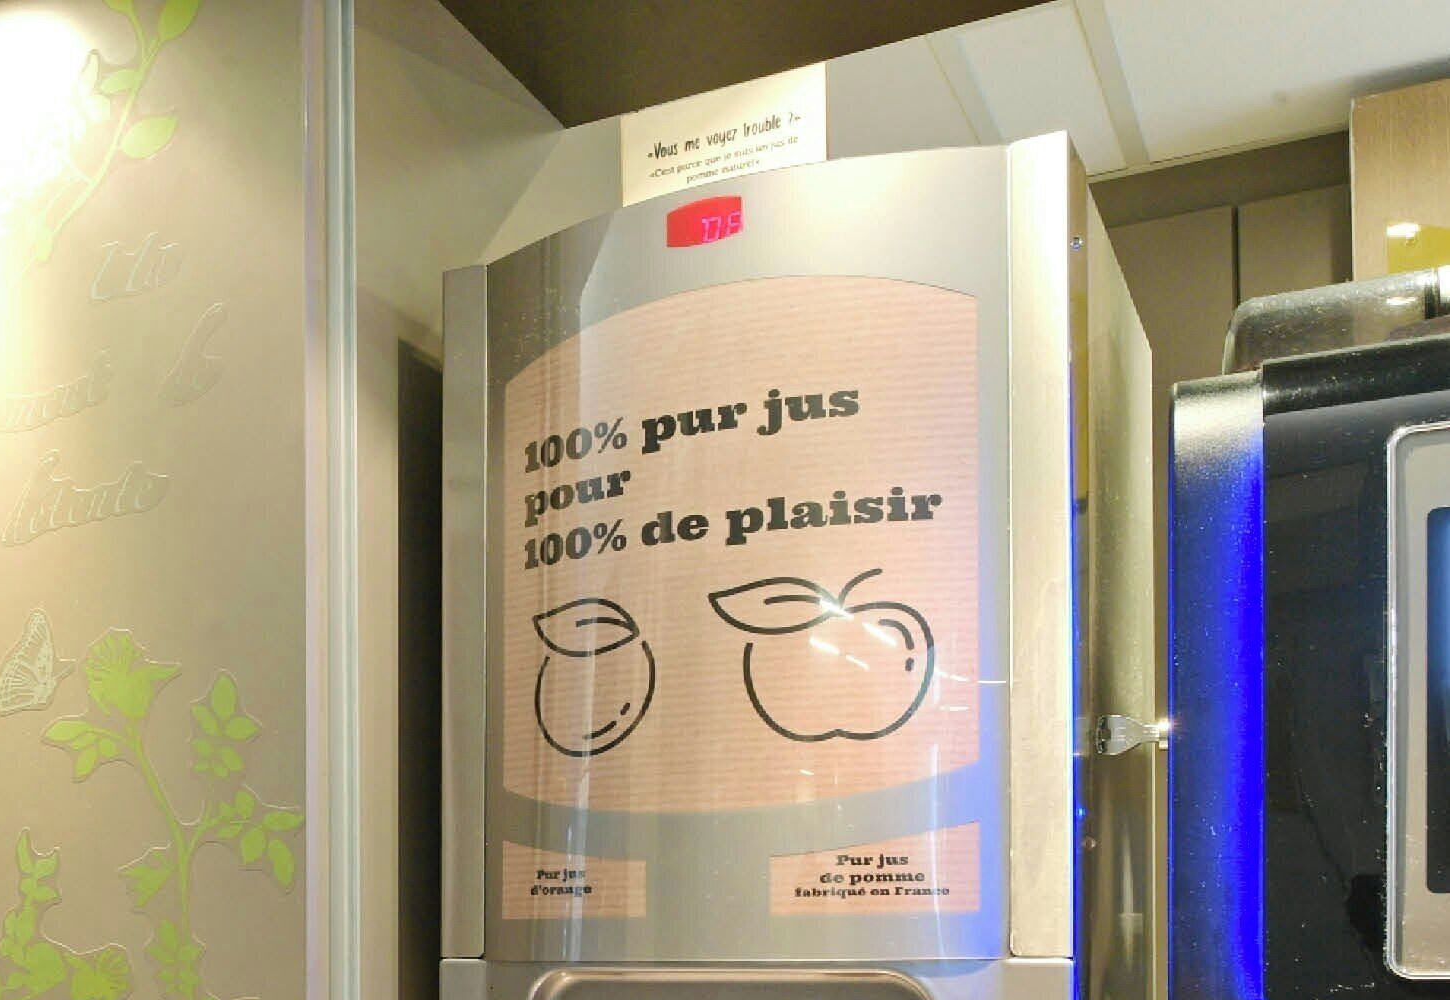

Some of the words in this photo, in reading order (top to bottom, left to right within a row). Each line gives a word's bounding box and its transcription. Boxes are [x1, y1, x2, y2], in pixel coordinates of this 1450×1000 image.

[685, 137, 700, 152] me
[707, 128, 737, 147] voyez
[743, 114, 781, 137] trouble
[524, 417, 628, 473] 100%
[641, 402, 748, 454] pur
[757, 389, 859, 436] jus
[524, 470, 632, 528] pour
[524, 519, 627, 570] 100%
[641, 511, 709, 546] de
[725, 486, 943, 546] plaisir
[836, 854, 874, 866] Pur
[876, 853, 909, 869] jus
[536, 870, 560, 880] Pur
[820, 872, 845, 884] de
[849, 872, 925, 886] pomme
[795, 887, 866, 899] fabriqué
[870, 888, 890, 896] en
[895, 886, 950, 896] France
